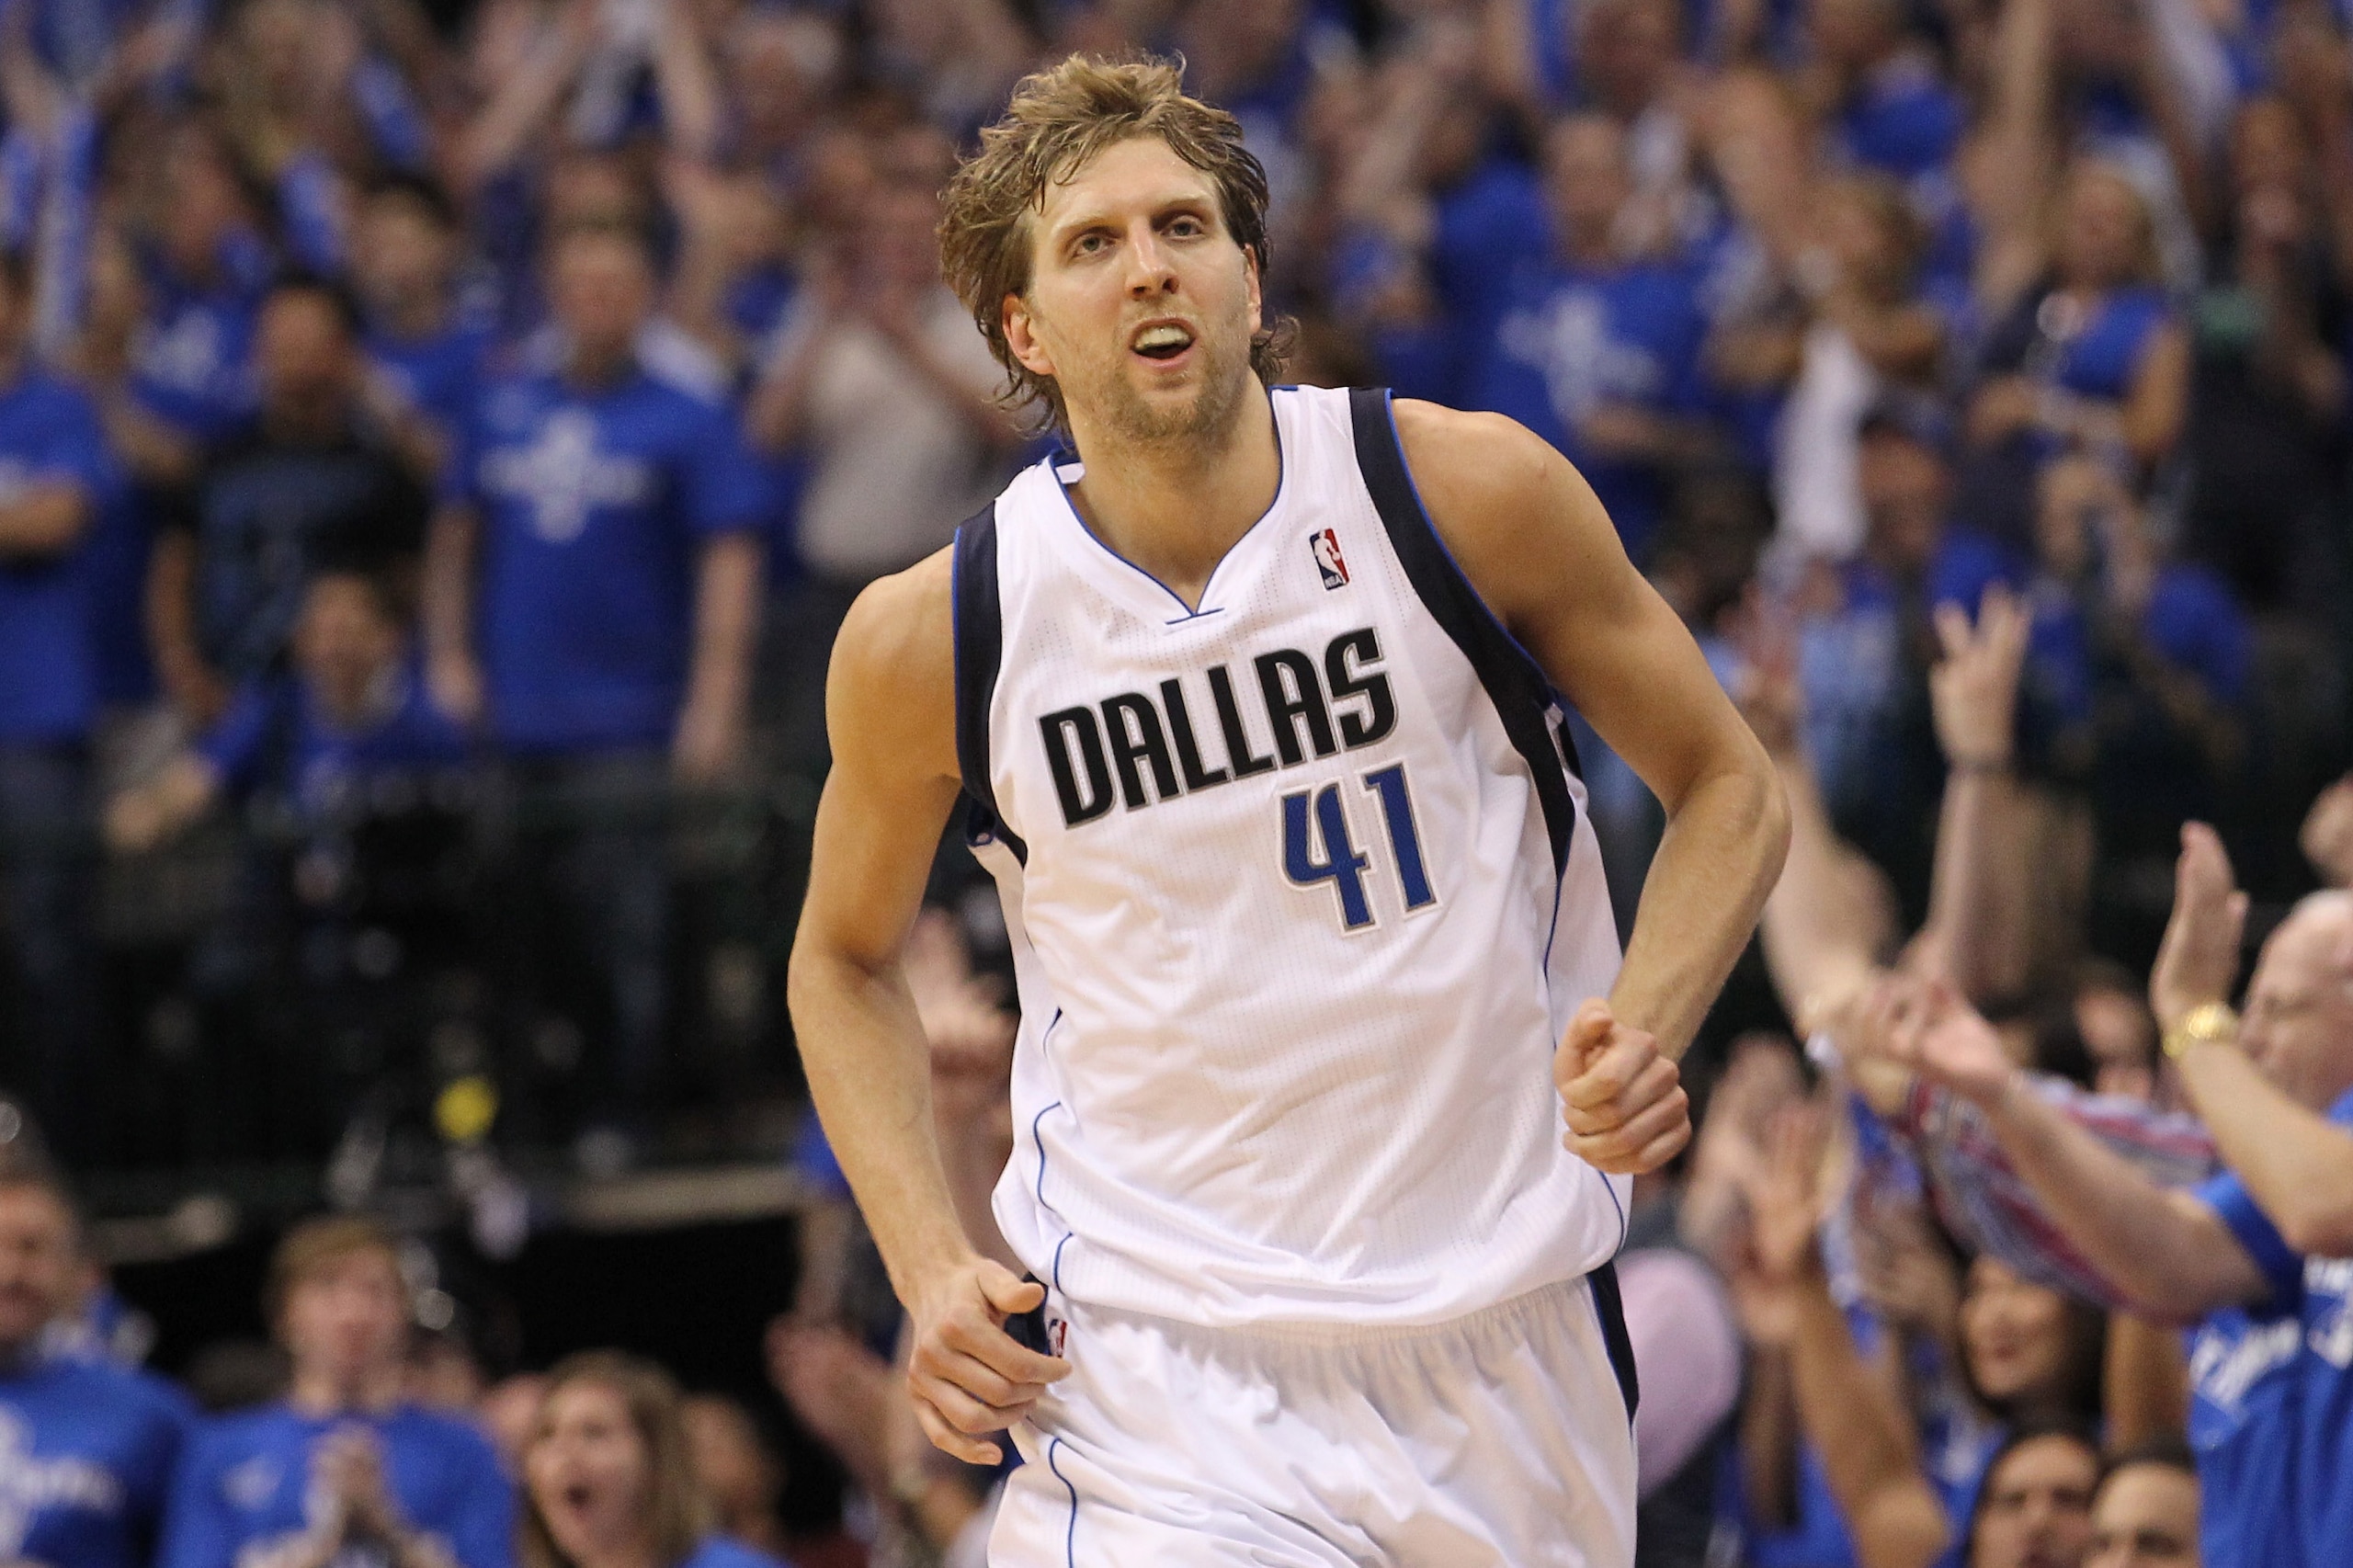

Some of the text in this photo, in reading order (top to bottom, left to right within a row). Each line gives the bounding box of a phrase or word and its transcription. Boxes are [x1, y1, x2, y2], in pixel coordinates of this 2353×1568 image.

[1324, 574, 1343, 589] NBA
[1037, 627, 1399, 830] DALLAS
[1279, 760, 1438, 934] 41
